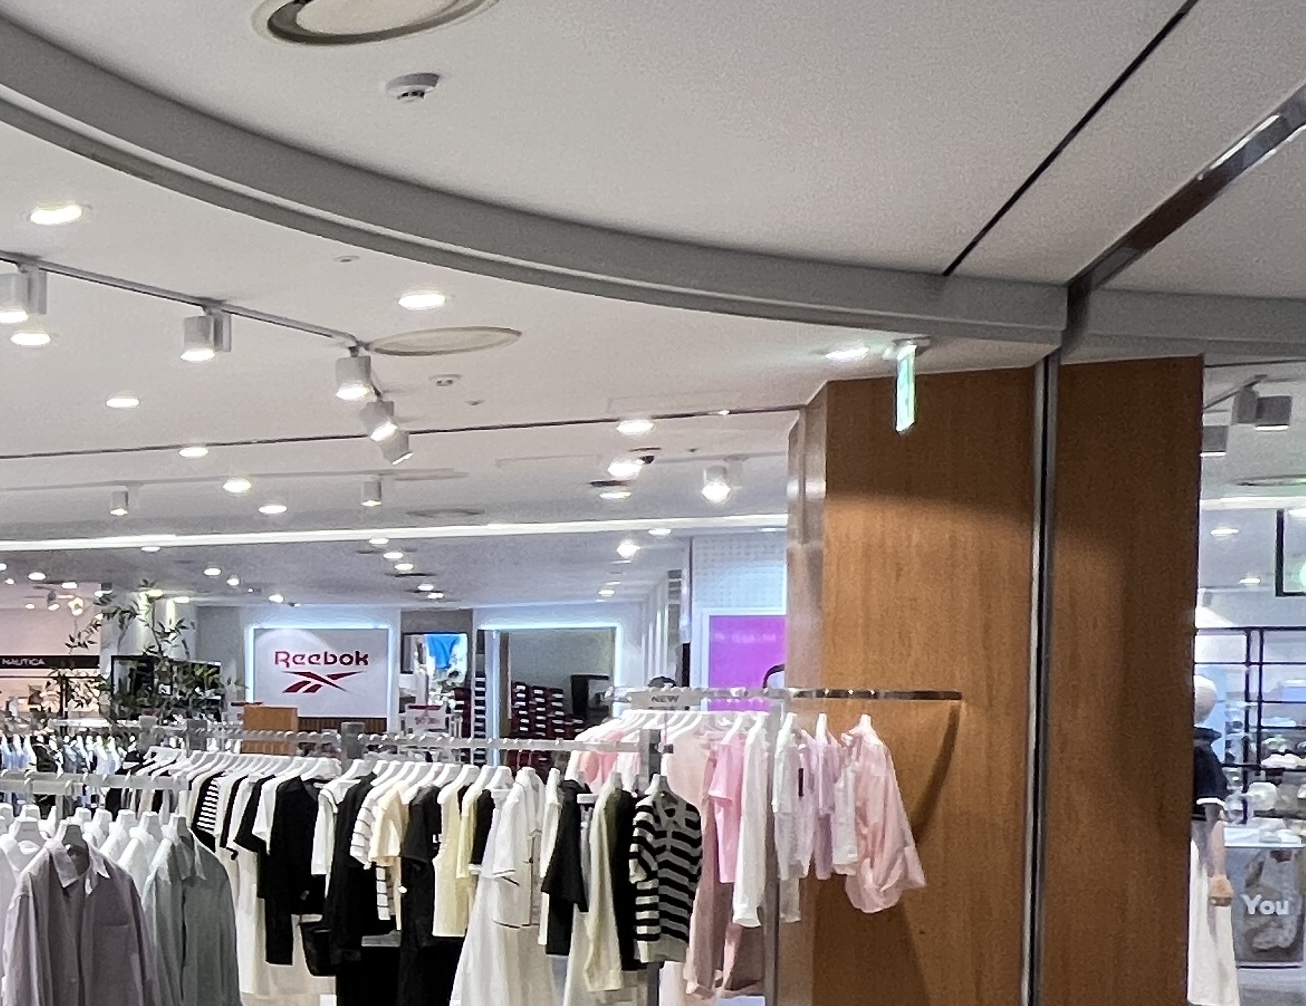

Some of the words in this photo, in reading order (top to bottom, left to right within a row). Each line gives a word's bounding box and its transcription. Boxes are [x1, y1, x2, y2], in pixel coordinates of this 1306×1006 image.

[1, 658, 46, 666] NAUTICA
[274, 651, 369, 668] Reebok
[650, 695, 680, 703] NEW
[1242, 893, 1289, 915] You
